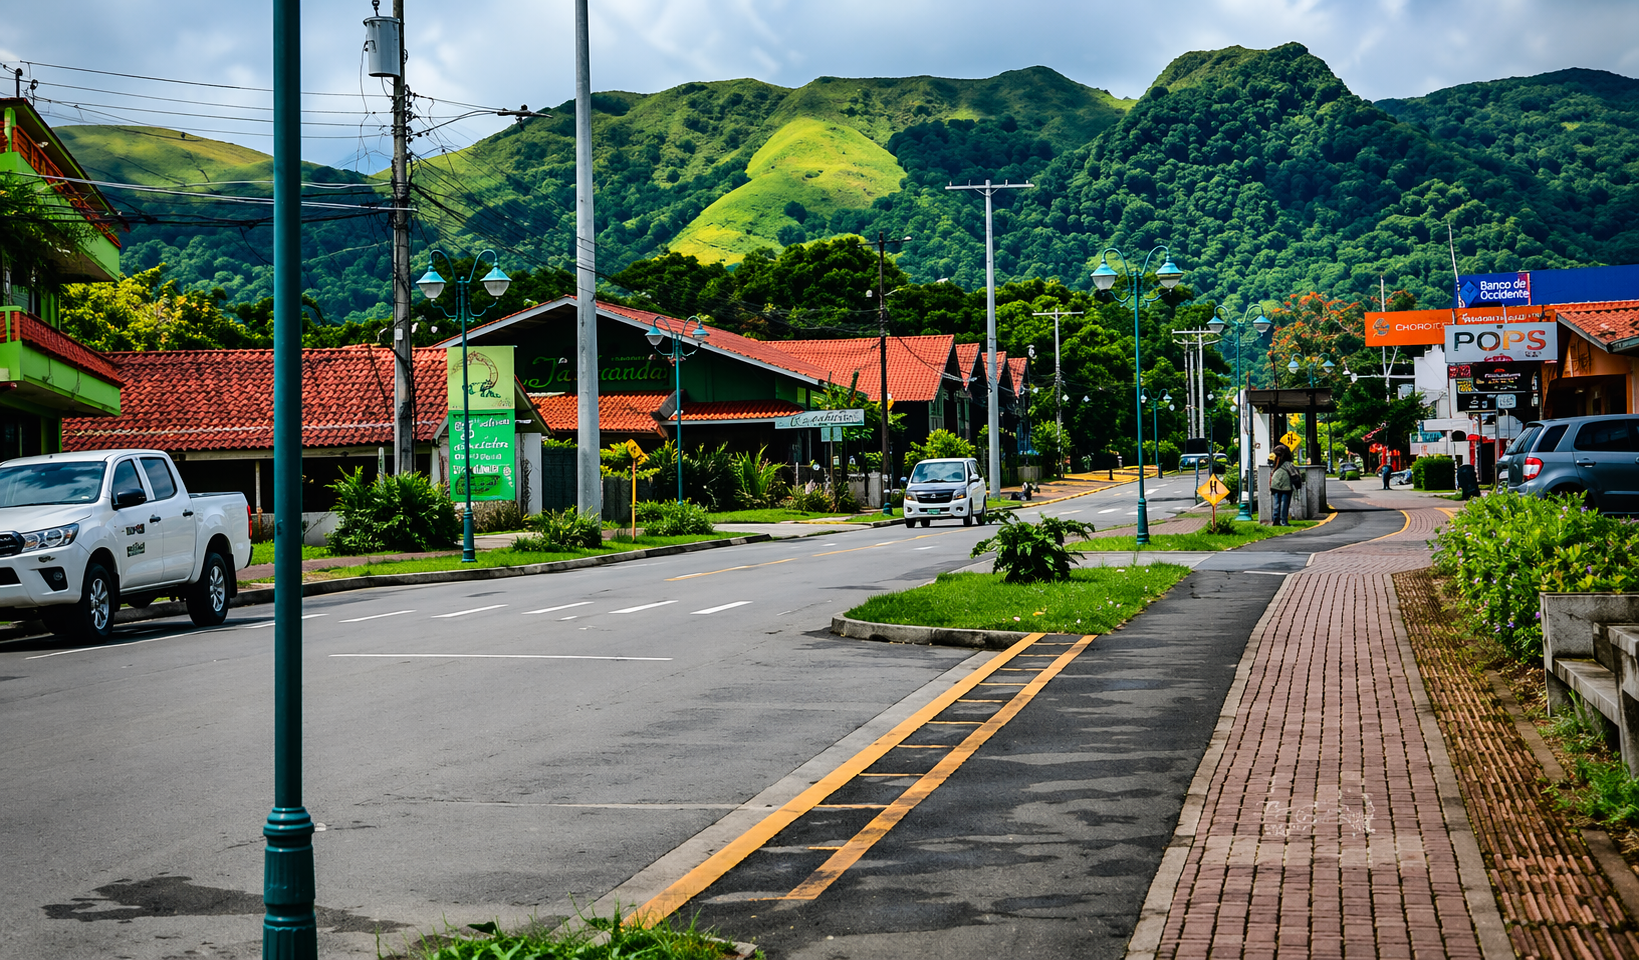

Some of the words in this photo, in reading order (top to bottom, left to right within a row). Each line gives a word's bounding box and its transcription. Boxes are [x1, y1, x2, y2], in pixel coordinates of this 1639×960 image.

[1480, 281, 1511, 290] Banco
[1513, 279, 1526, 288] de
[1480, 290, 1529, 300] Occidente
[1454, 330, 1546, 351] POPS
